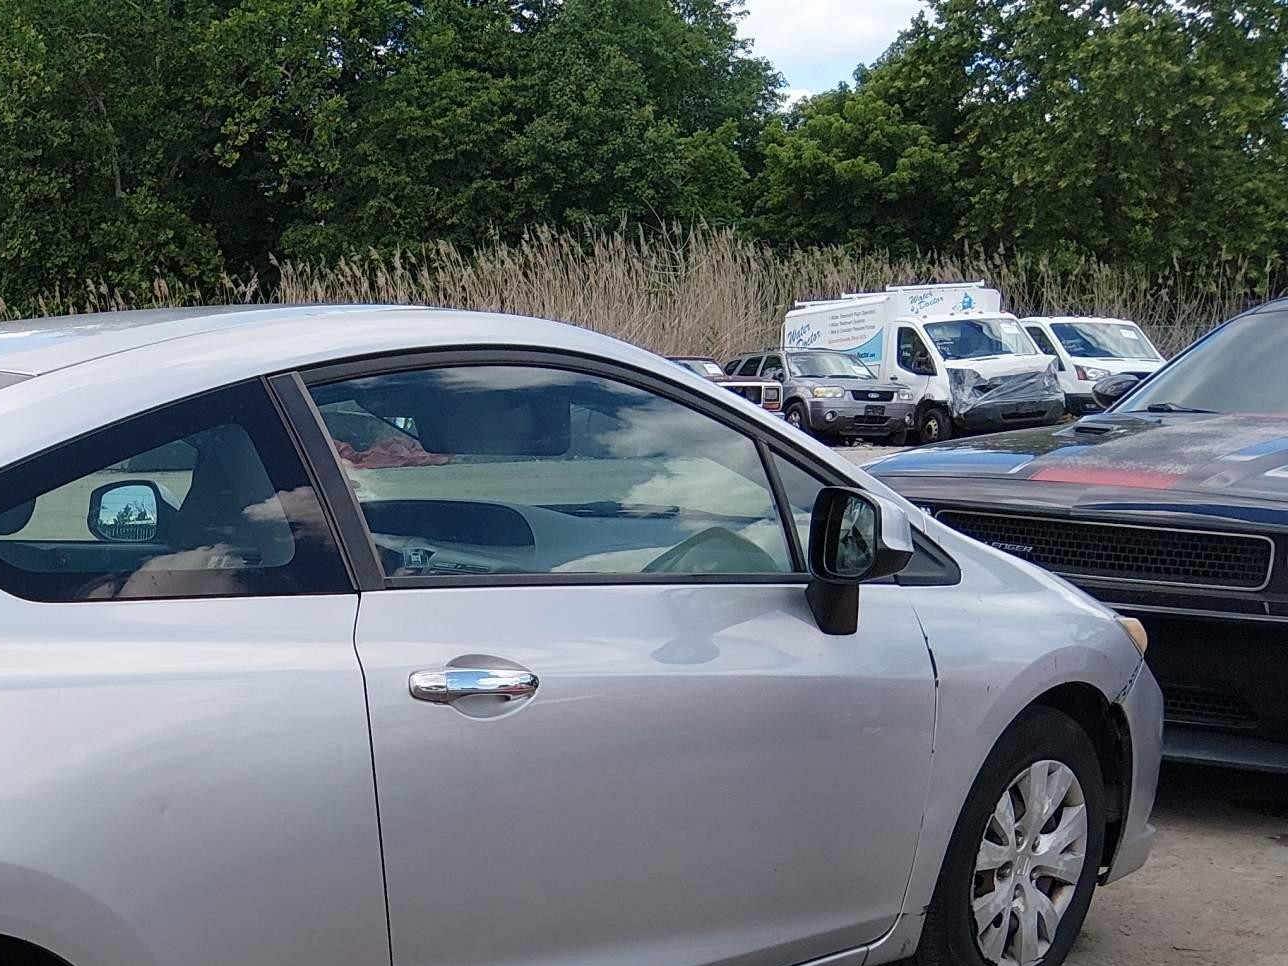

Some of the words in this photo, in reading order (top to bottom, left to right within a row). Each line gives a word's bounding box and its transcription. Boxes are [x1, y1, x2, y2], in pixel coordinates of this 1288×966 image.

[909, 290, 933, 304] Water
[918, 297, 944, 309] Doctor
[787, 323, 811, 344] Water
[796, 331, 822, 347] Doctor
